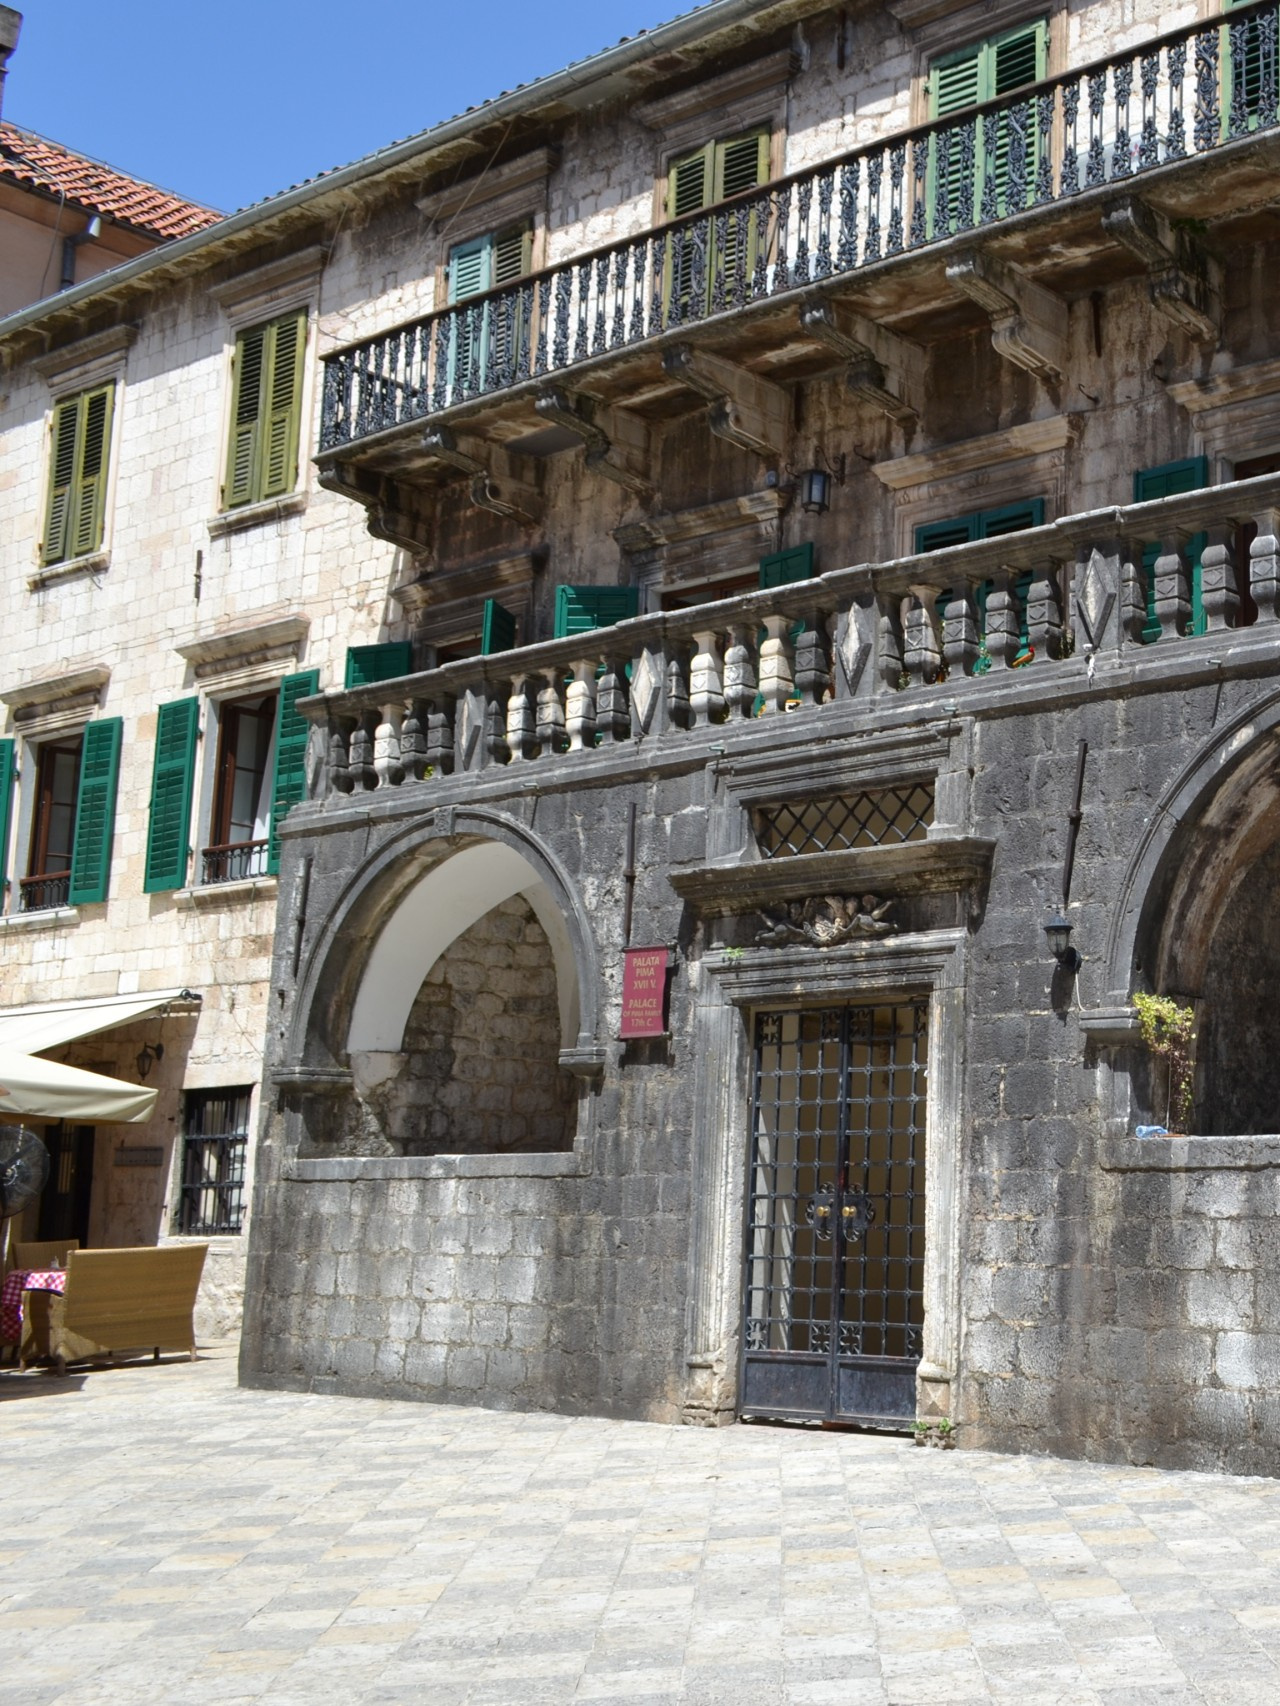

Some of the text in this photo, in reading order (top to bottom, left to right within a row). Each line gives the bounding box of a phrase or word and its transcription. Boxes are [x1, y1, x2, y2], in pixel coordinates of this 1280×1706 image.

[632, 956, 660, 967] PALATA
[636, 967, 655, 977] PIMA
[633, 980, 649, 990] XVII
[628, 998, 657, 1008] PALACE
